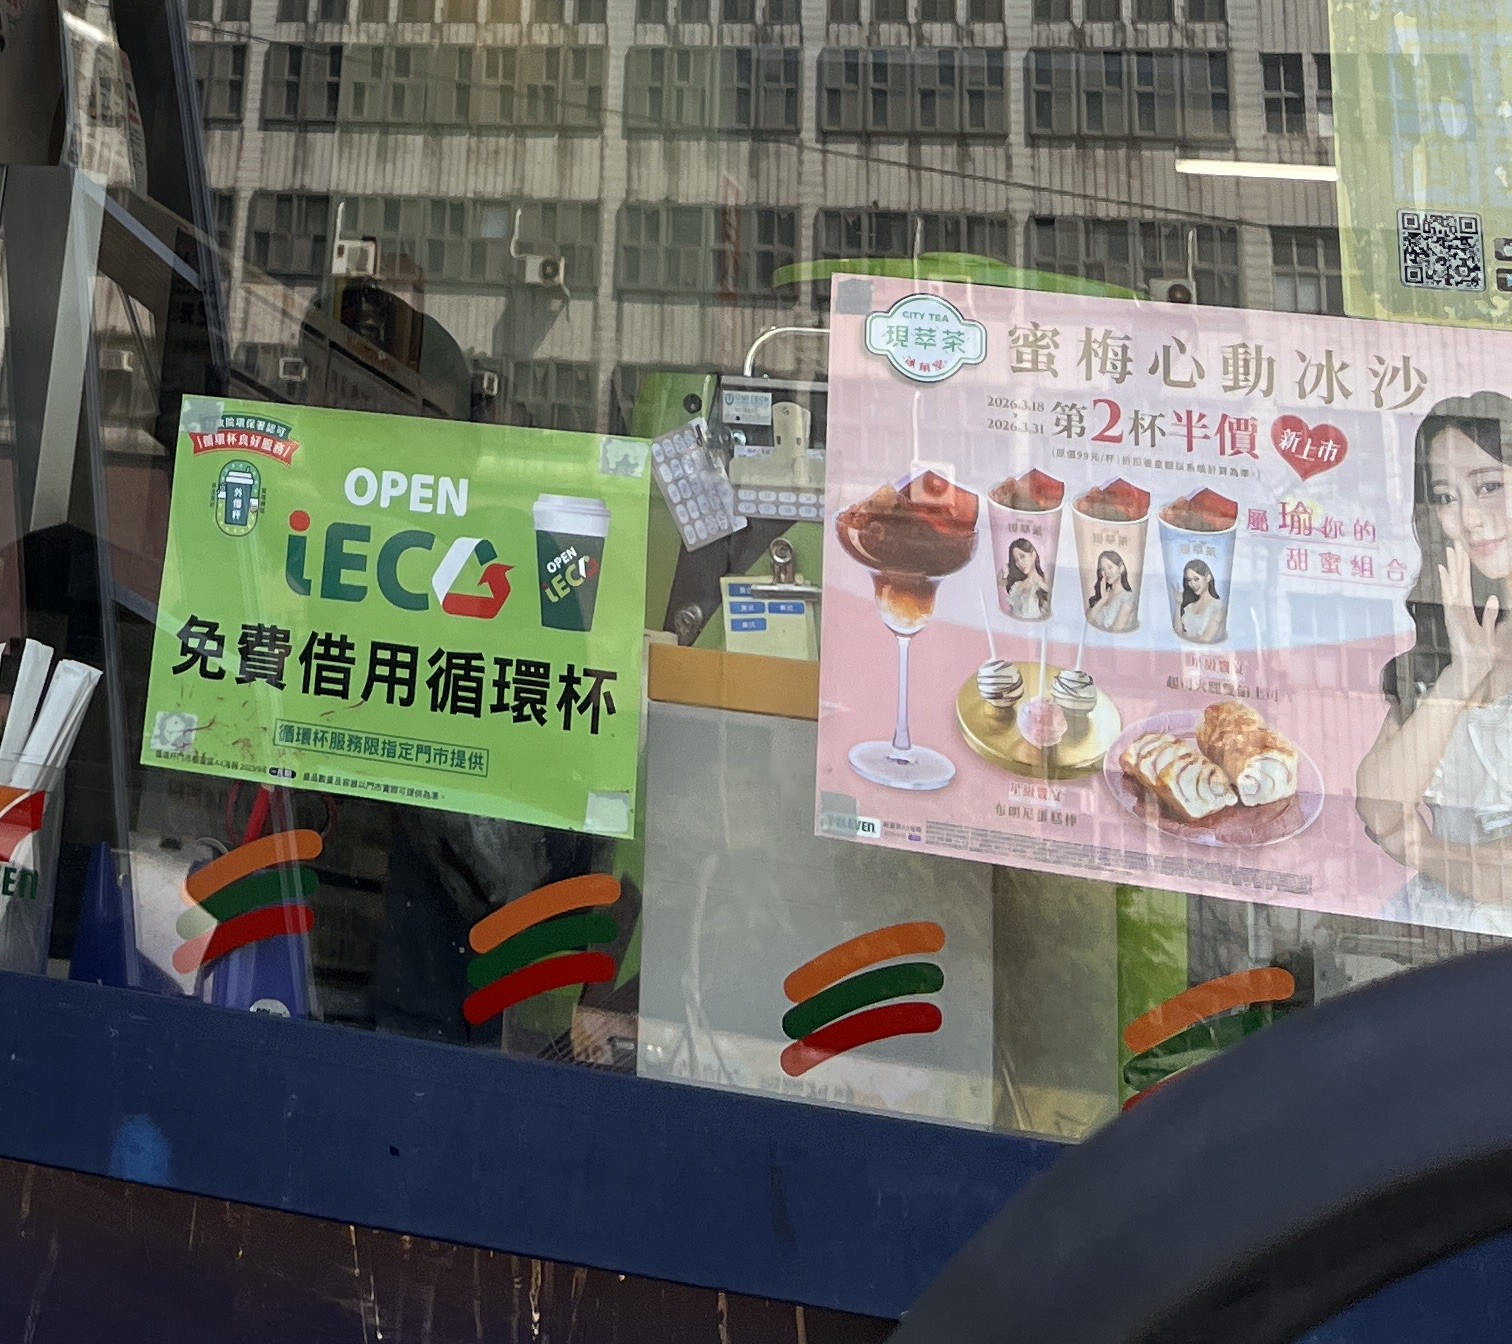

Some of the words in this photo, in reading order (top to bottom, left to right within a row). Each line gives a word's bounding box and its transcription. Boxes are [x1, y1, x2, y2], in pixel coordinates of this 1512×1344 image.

[886, 324, 966, 354] 現萃茶
[902, 311, 925, 321] CITY
[929, 312, 949, 323] TEA
[1008, 320, 1428, 411] 蜜梅心動冰沙
[1051, 398, 1260, 460] 第2杯半價
[1278, 428, 1341, 463] 新上市
[344, 466, 470, 518] OPEN
[546, 545, 578, 574] OPEN
[171, 614, 619, 737] 免費借用循環杯
[278, 723, 485, 772] 循環杯服務限指定門市提供
